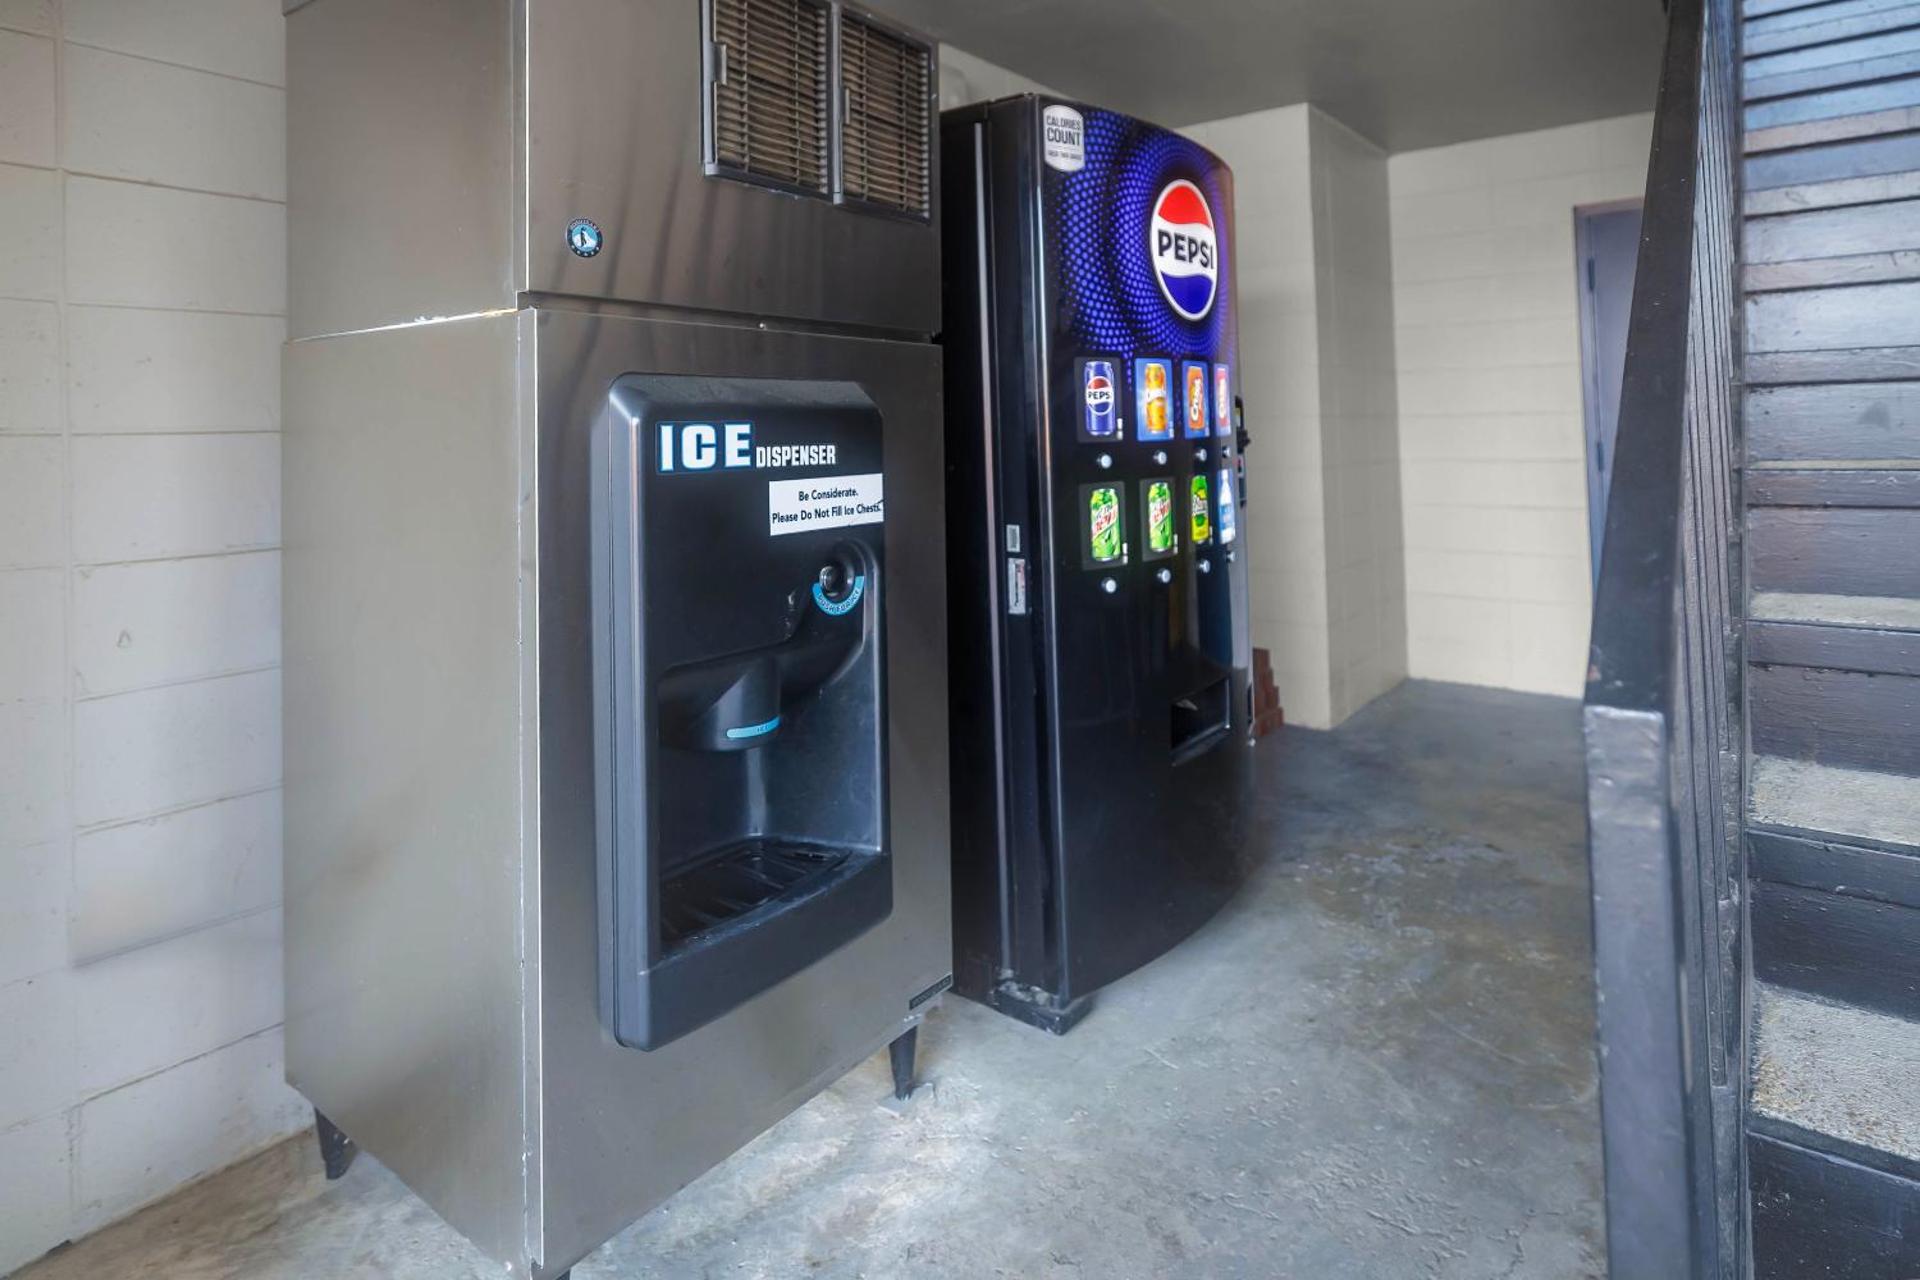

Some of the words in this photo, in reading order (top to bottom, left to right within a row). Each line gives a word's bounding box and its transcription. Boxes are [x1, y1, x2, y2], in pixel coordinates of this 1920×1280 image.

[1046, 127, 1080, 146] COUNT
[1158, 229, 1214, 269] PEPSI
[660, 423, 751, 471] ICE
[756, 445, 836, 468] DISPENSER
[798, 491, 809, 501] Be
[811, 488, 859, 501] Considerate.
[772, 512, 798, 524] Please
[801, 510, 812, 521] Do
[815, 508, 830, 519] Not
[831, 505, 842, 517] Fill
[844, 506, 854, 516] Ice
